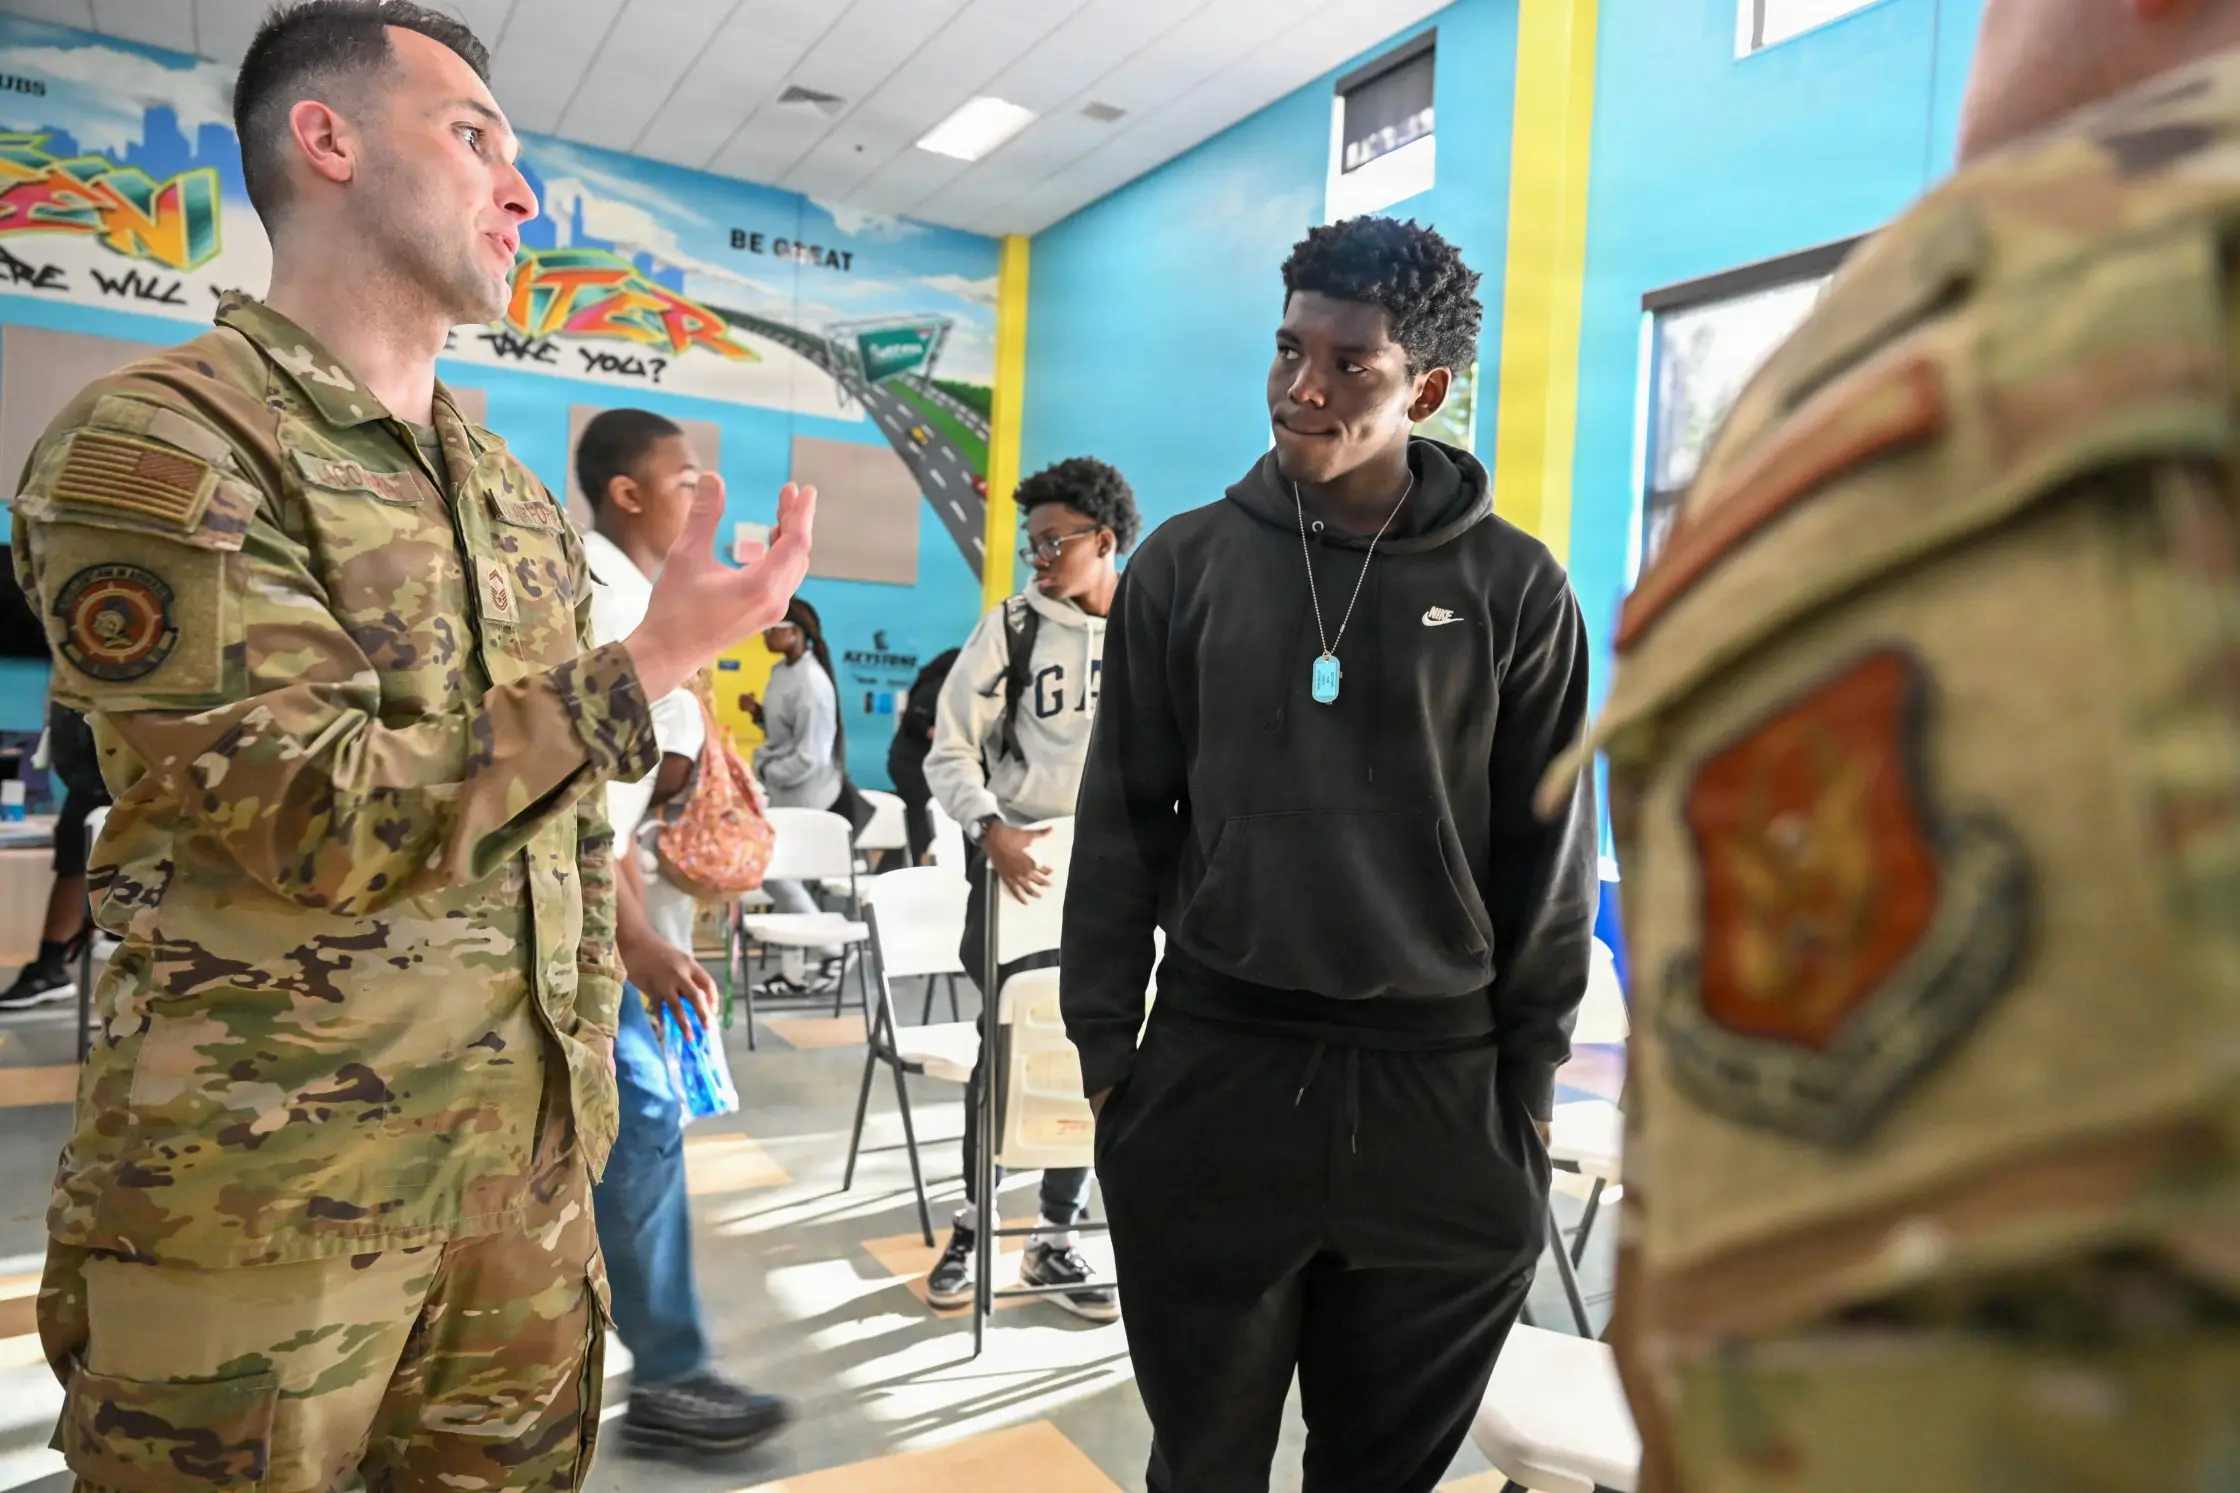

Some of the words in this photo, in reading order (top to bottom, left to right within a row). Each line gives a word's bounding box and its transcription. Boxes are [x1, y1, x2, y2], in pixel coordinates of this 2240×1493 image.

[731, 227, 765, 255] BE
[773, 237, 854, 272] GREAT
[90, 268, 188, 305] WILL
[578, 346, 667, 384] YOU?
[1429, 606, 1454, 621] NIKE
